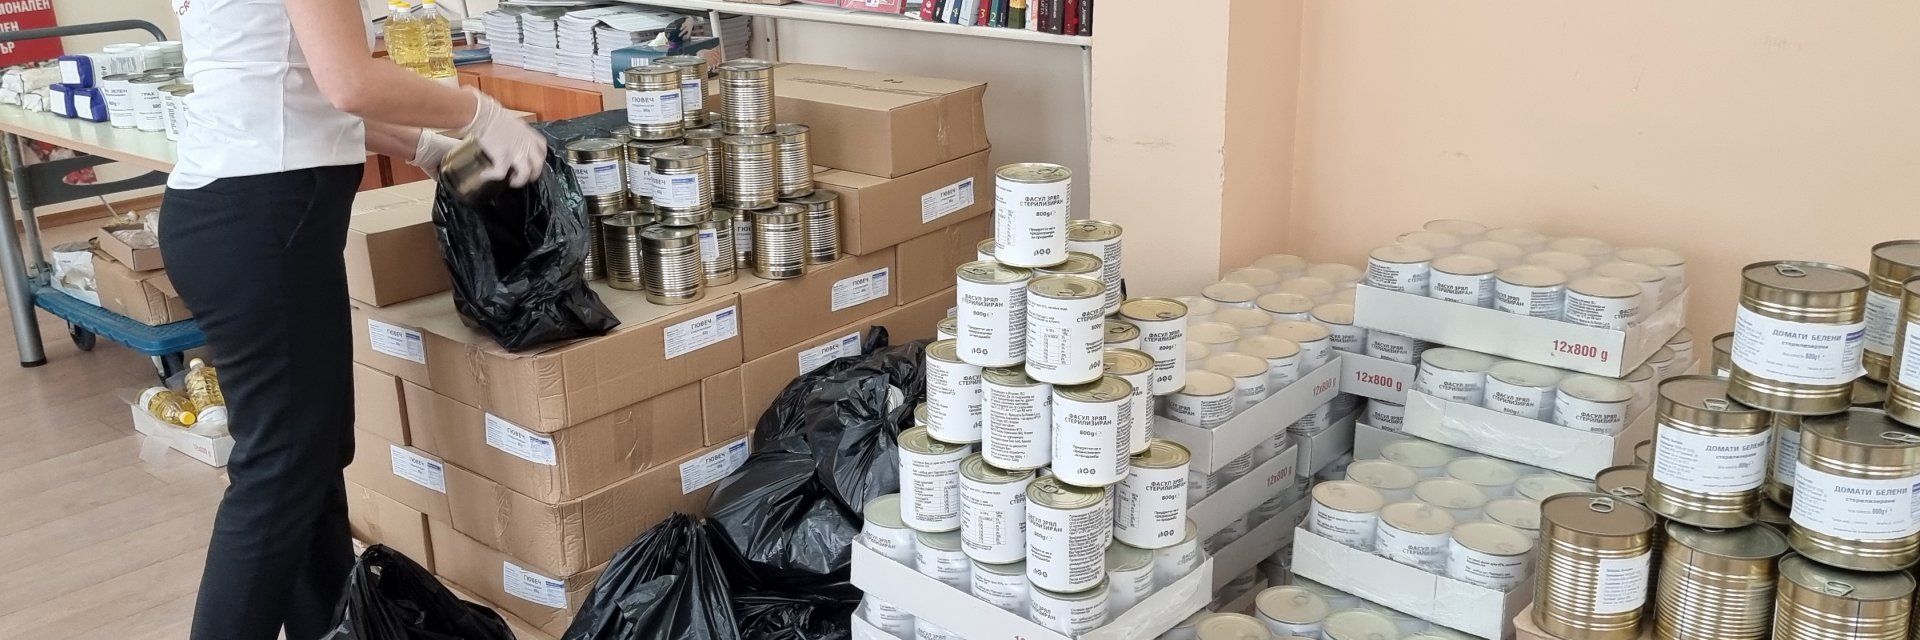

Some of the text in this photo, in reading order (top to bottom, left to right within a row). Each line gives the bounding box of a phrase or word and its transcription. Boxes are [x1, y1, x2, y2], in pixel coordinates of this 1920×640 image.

[1772, 329, 1842, 342] ДОМАТИ БЕЛЕНИ
[1552, 339, 1609, 362] 12x800 g
[1355, 370, 1403, 392] 12x800 g
[1496, 391, 1514, 400] ФАСУЛ
[1580, 411, 1603, 419] ФАСУЛ
[1064, 417, 1112, 426] СТЕРИЛИЗИРАН
[1742, 440, 1765, 451] БЕЛЕНИ
[1834, 485, 1908, 496] ДОМАТИ БЕЛЕНИ
